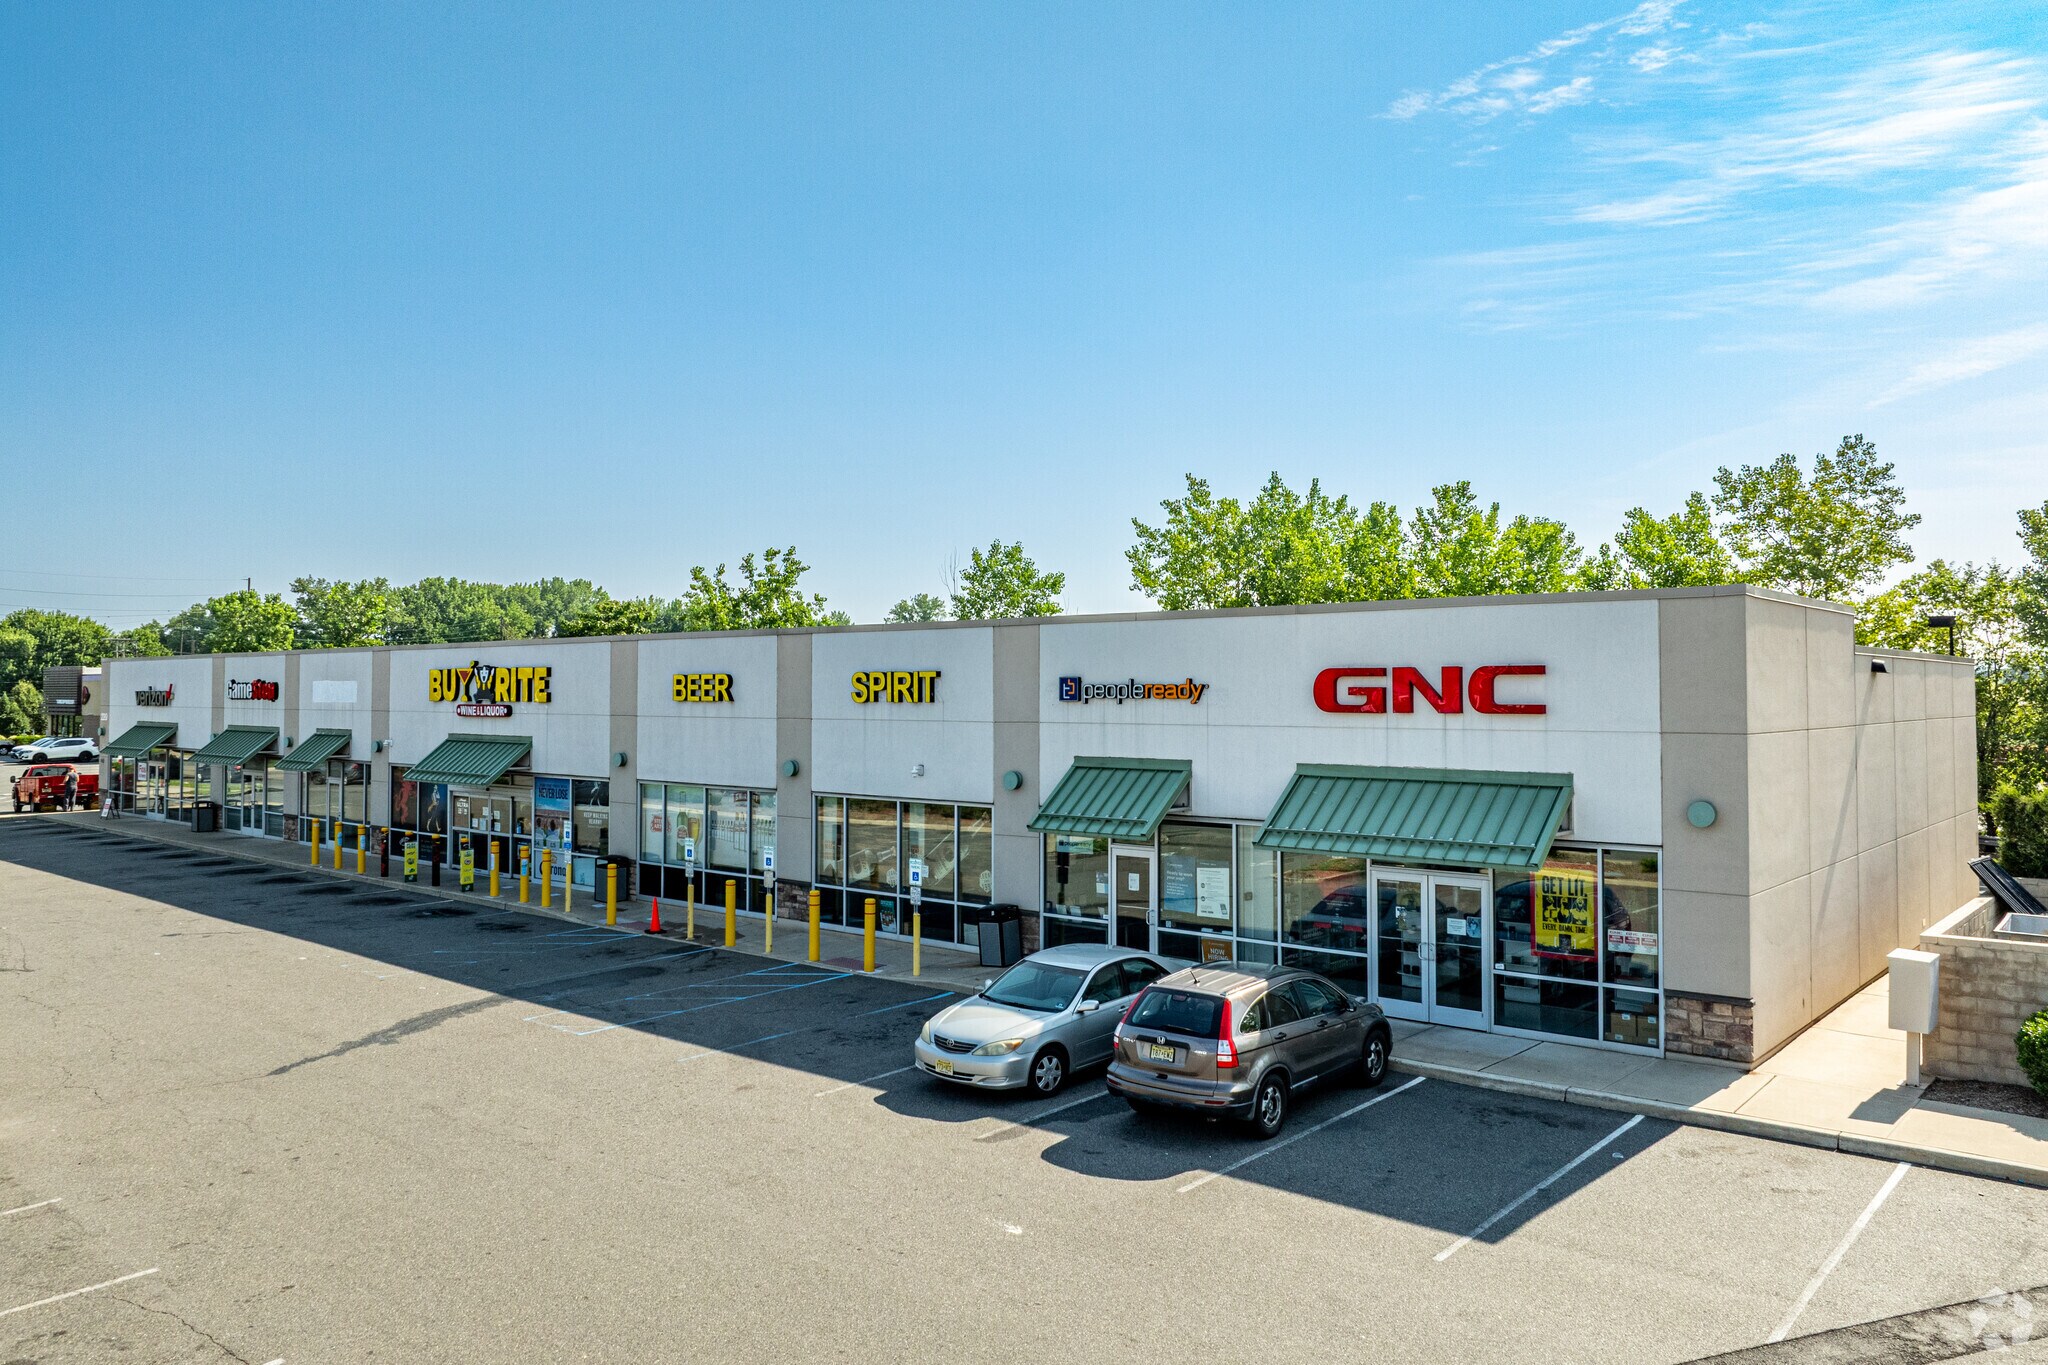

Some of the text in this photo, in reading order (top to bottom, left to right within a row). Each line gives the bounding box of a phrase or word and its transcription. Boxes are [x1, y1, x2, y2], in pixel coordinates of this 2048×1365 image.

[135, 685, 170, 706] verizon
[429, 666, 550, 703] BUY RITE
[672, 673, 733, 702] BEER
[851, 670, 940, 704] SPIRIT
[1313, 664, 1547, 715] GNC
[460, 705, 476, 716] WINE
[480, 705, 505, 716] LIQUOR
[556, 788, 568, 800] LOSE
[1542, 876, 1588, 898] GET LIT.
